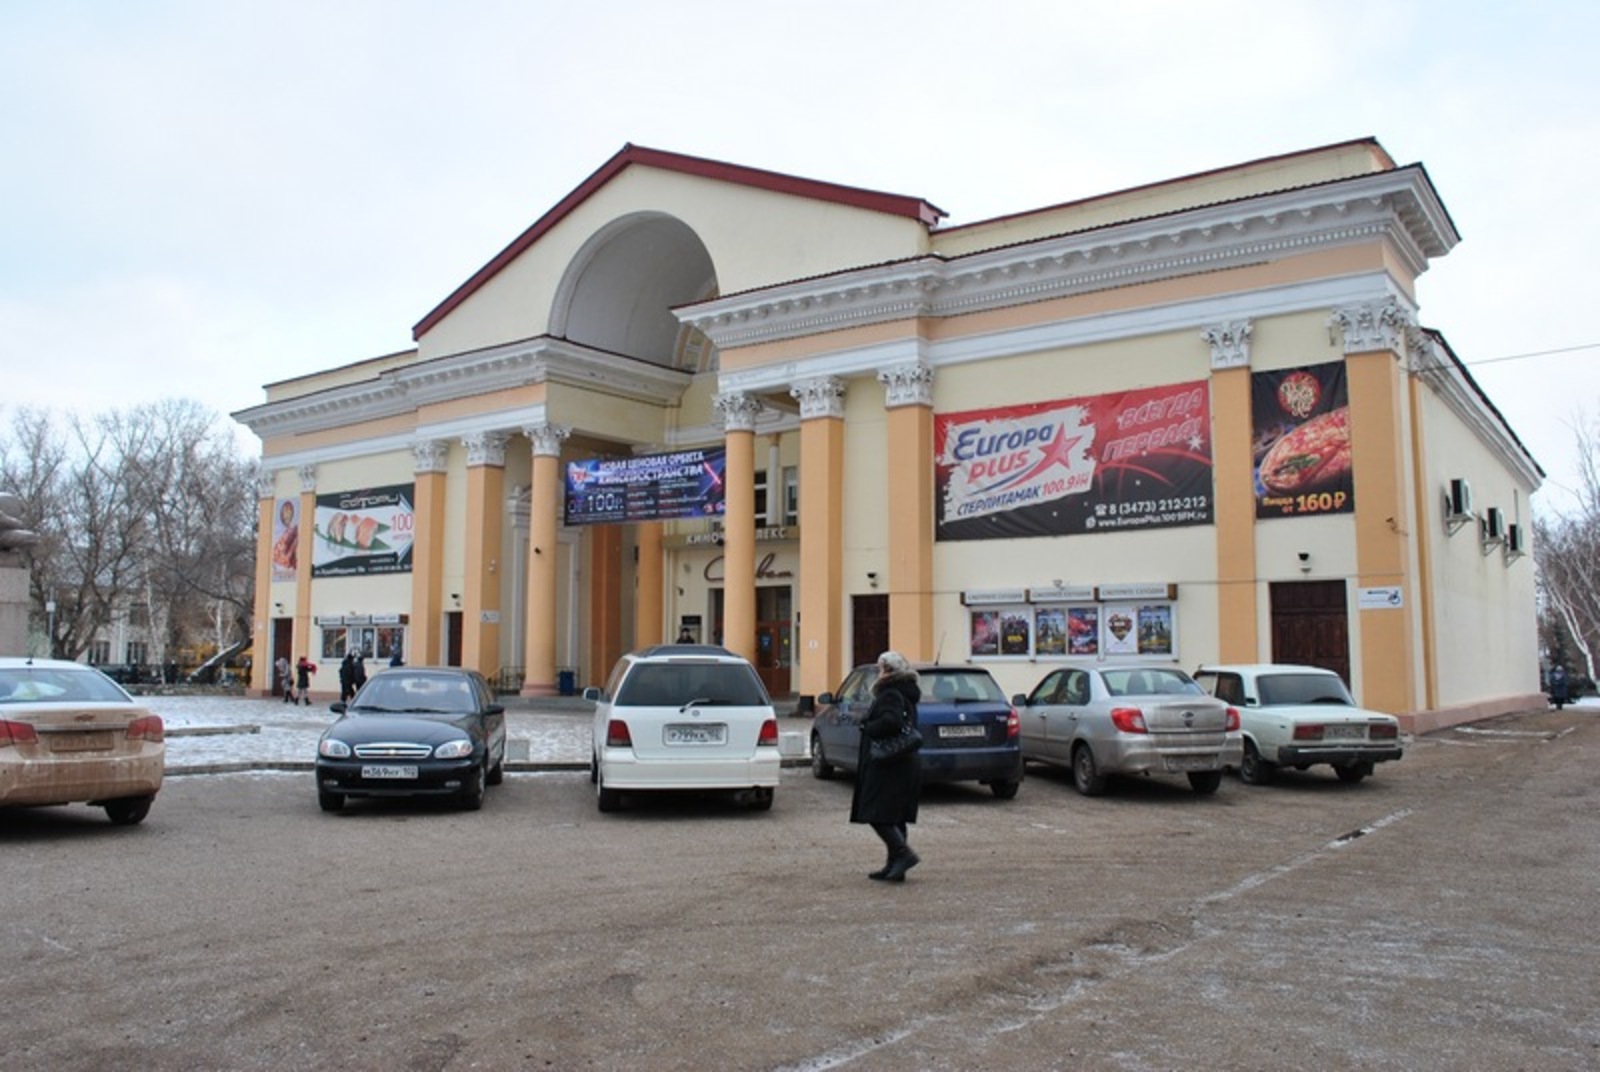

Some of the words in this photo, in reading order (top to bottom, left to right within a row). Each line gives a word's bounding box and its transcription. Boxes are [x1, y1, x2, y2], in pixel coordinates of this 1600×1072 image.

[957, 484, 1042, 516] СТЕРЛИТАМАК
[1109, 504, 1116, 515] 8
[1119, 501, 1157, 515] (3473)
[1159, 496, 1207, 511] 212-212
